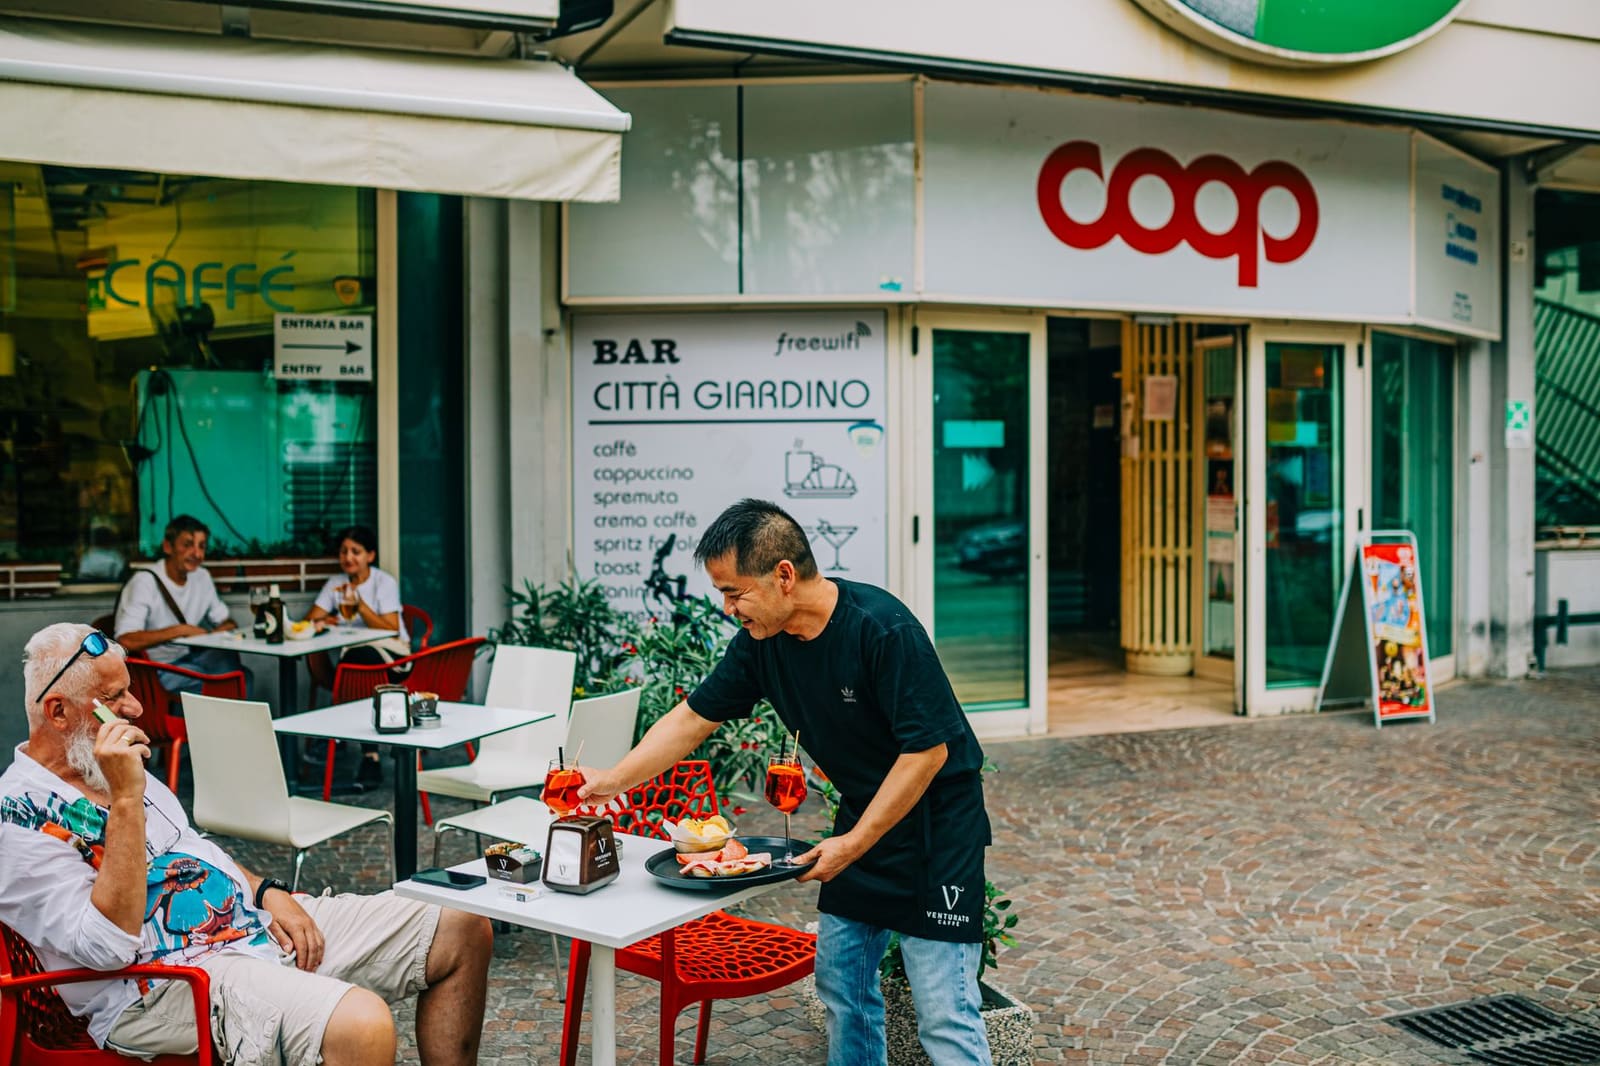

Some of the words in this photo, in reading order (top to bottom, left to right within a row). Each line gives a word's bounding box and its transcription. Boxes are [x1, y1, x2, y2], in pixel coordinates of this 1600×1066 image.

[1037, 140, 1319, 287] coop
[281, 318, 336, 330] ENTRATA
[339, 320, 364, 331] BAR
[593, 338, 680, 365] BAR
[775, 332, 861, 357] freewifi
[281, 364, 322, 375] ENTRY
[339, 365, 364, 375] BAR
[594, 374, 680, 411] CITTÀ
[694, 380, 870, 410] GIARDINO
[593, 465, 694, 485] cappuccino
[593, 490, 679, 509] spremuta
[594, 514, 647, 528] crema
[594, 537, 643, 556] spritz
[648, 534, 701, 552] faol
[594, 561, 641, 576] toast
